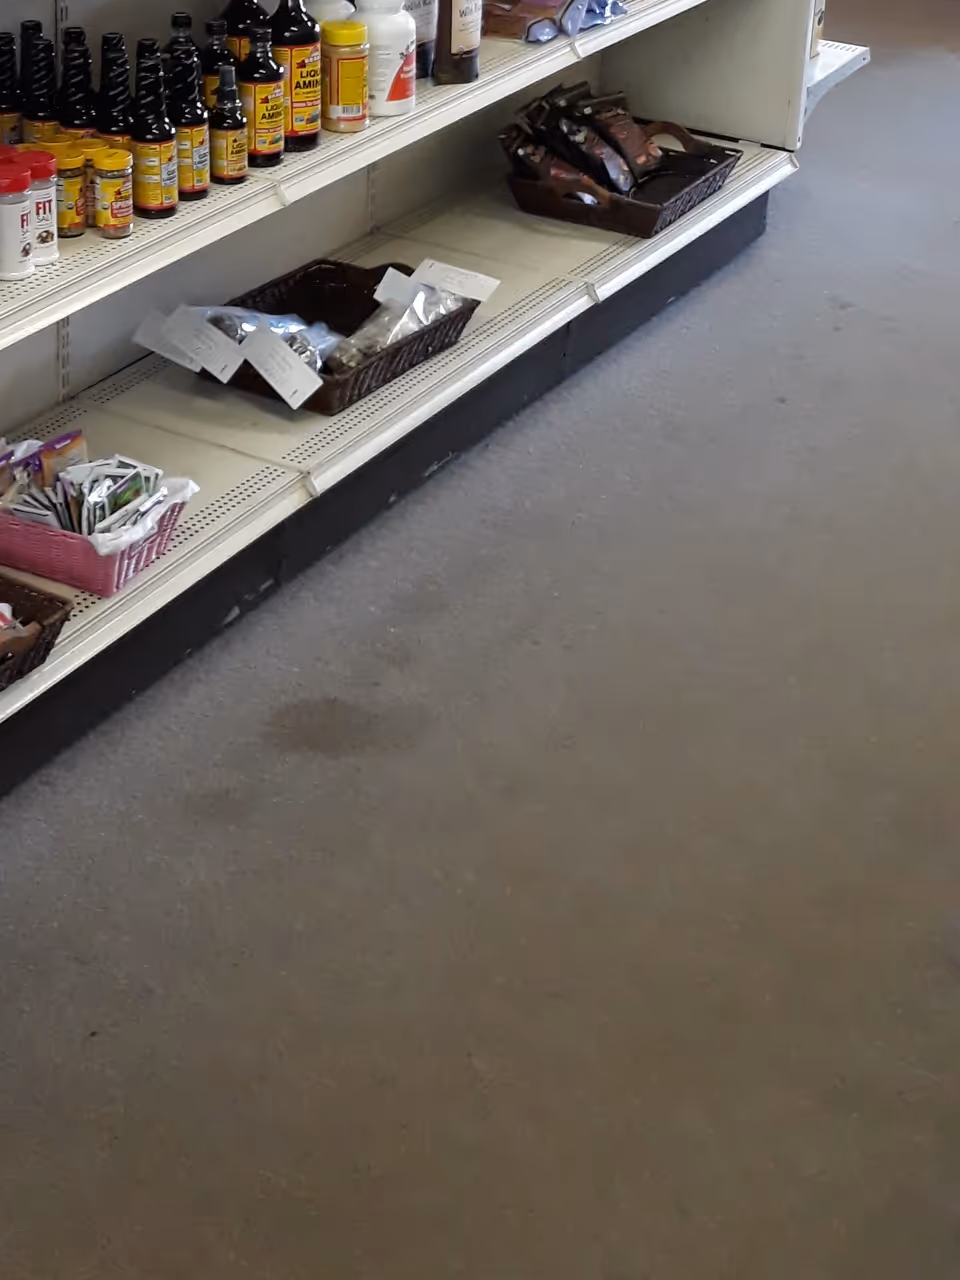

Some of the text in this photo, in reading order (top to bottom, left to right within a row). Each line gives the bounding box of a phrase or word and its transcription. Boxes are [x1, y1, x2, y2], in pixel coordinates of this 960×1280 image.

[294, 80, 320, 90] AMIN
[261, 111, 283, 120] AMIN
[35, 199, 53, 216] FIT
